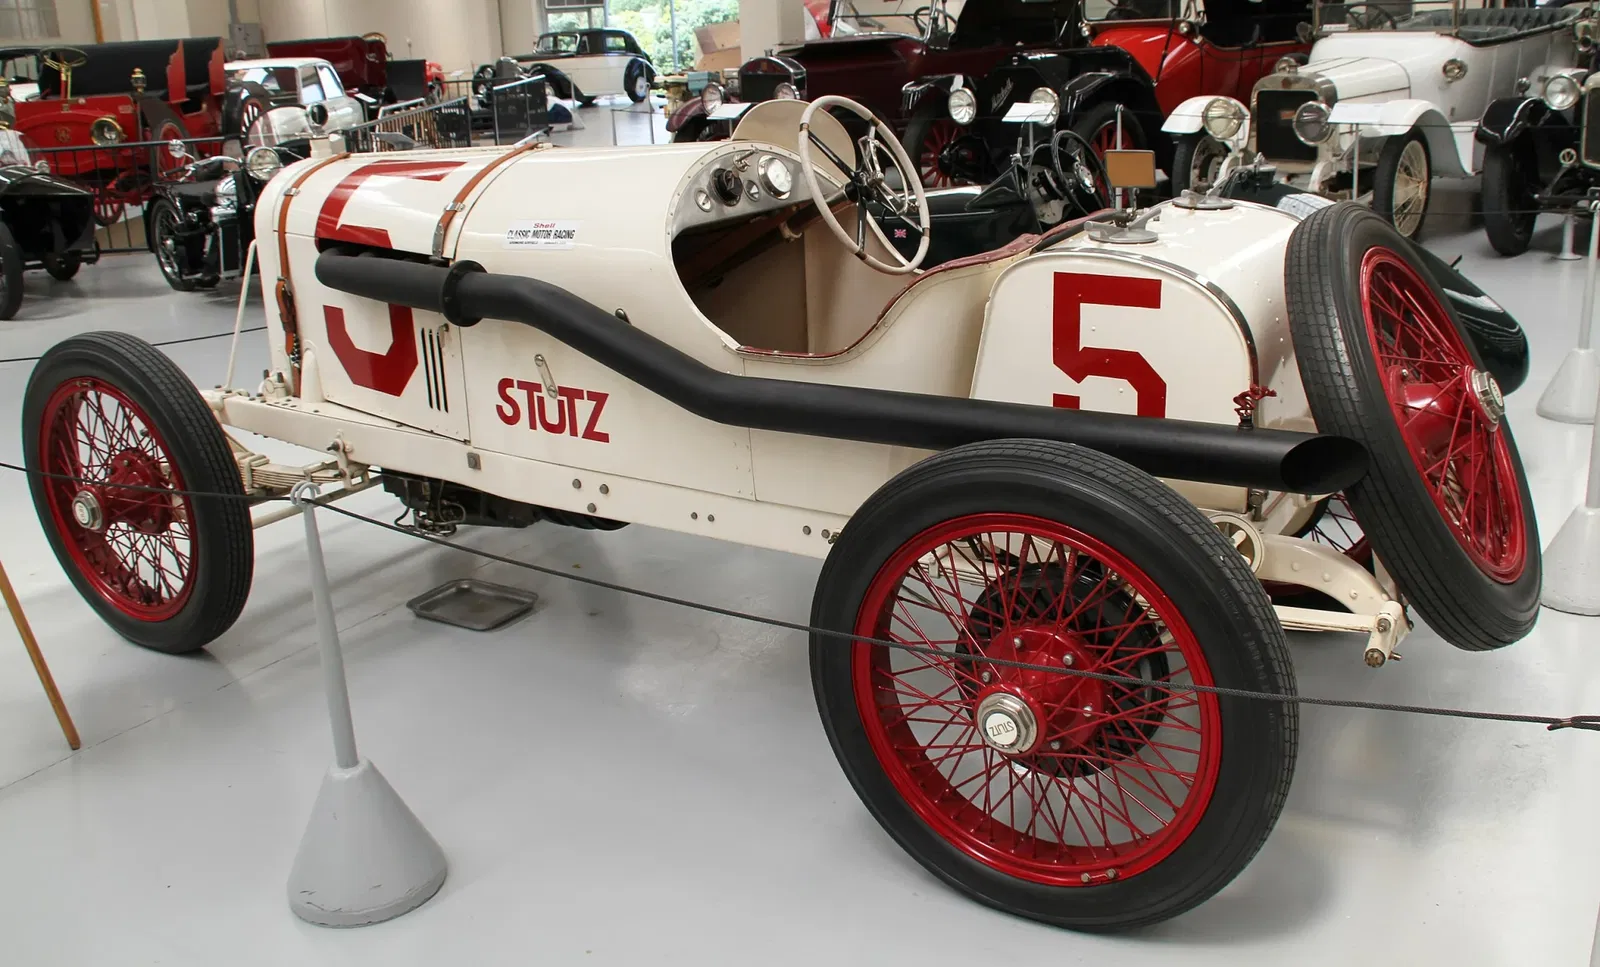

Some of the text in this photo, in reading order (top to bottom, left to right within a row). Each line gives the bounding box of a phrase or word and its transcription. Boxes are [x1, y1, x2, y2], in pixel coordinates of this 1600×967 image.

[507, 230, 576, 239] CLASSIC MOTOR RACING
[1053, 272, 1167, 418] 5
[496, 378, 609, 443] STUTZ
[989, 721, 1015, 737] STUTZ
